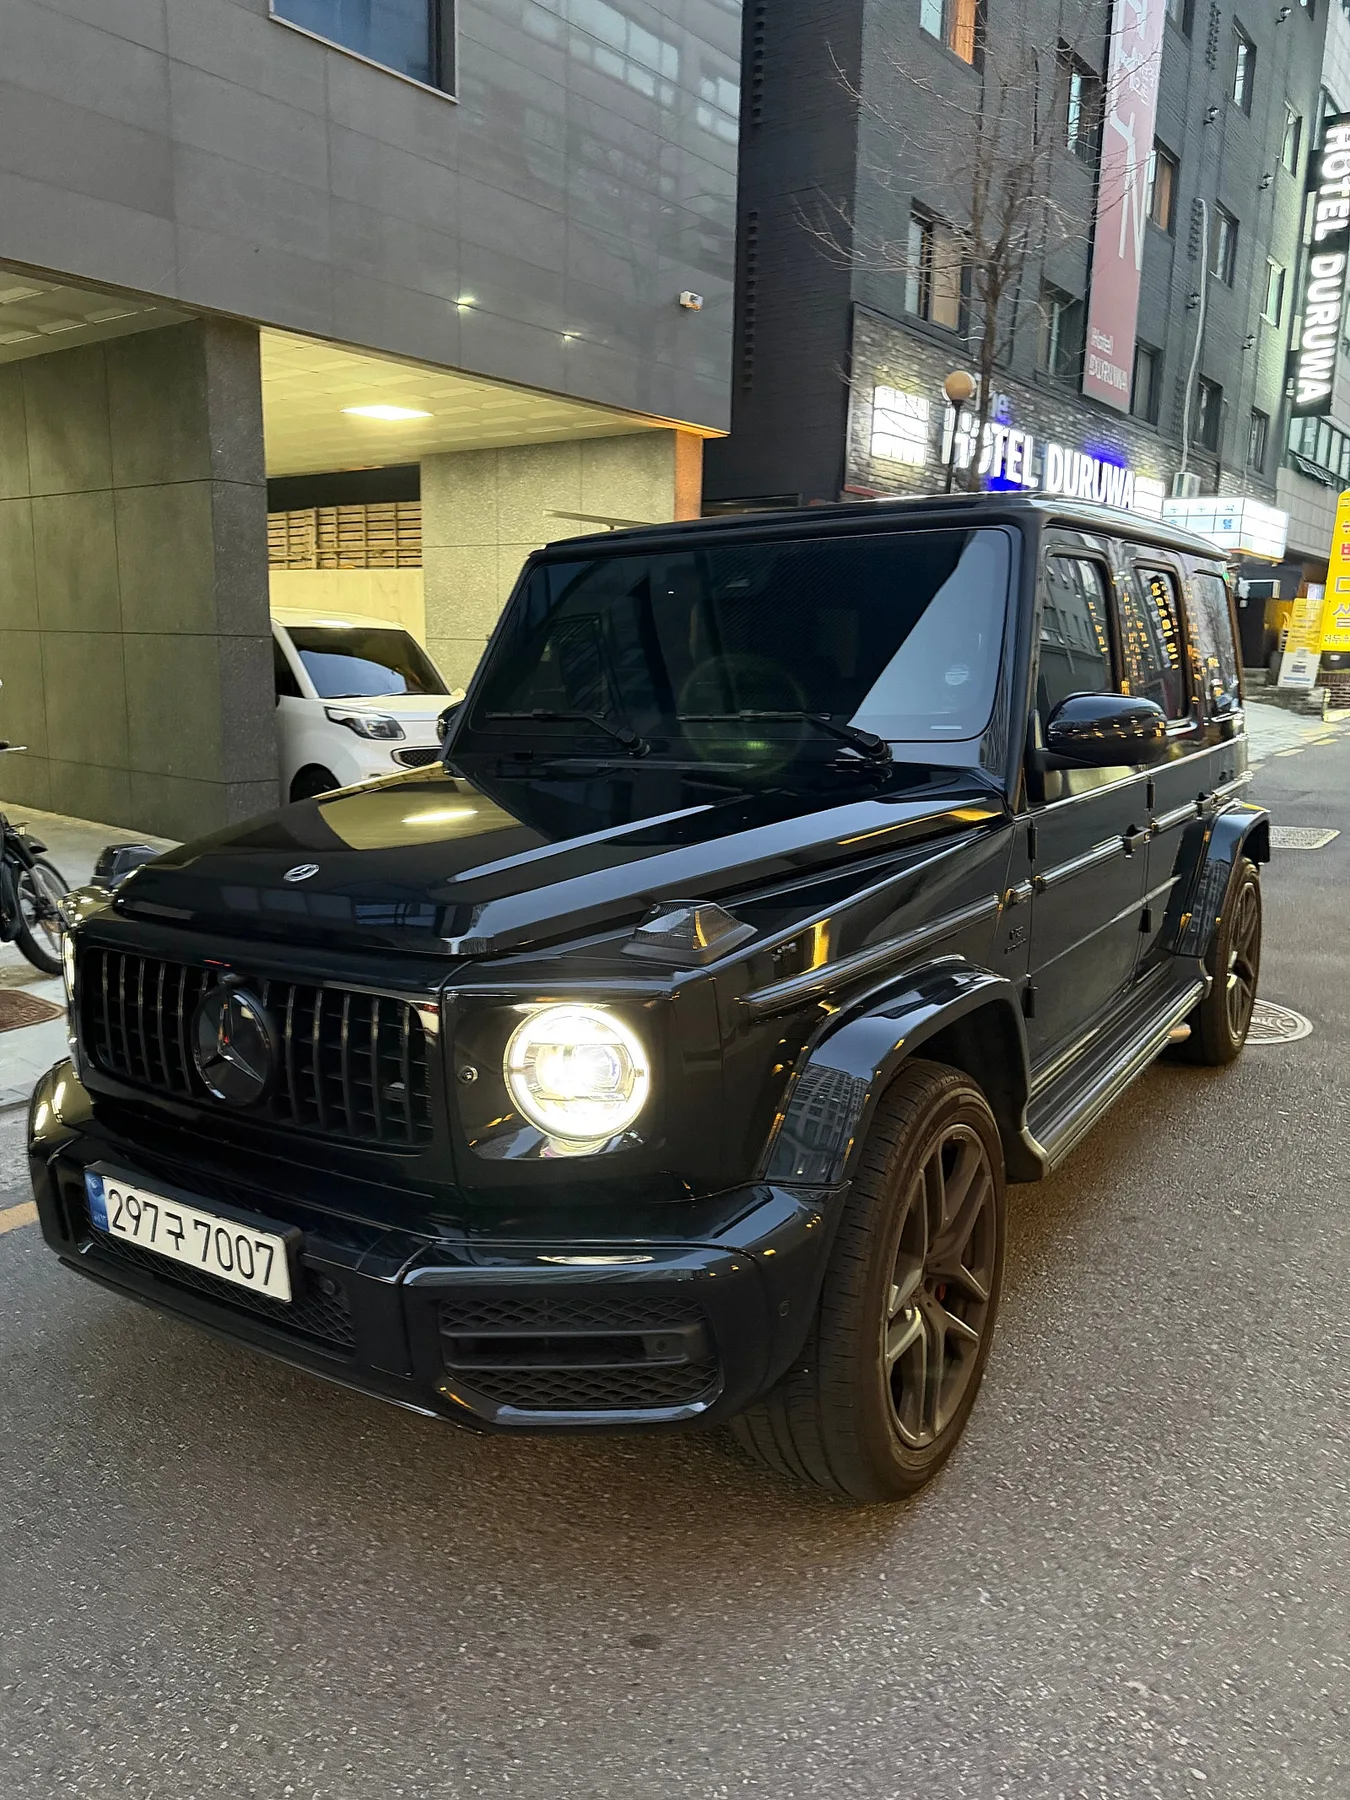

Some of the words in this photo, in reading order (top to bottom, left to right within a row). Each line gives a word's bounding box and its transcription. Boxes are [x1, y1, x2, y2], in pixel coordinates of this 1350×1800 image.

[1314, 125, 1350, 241] HOTEL
[1296, 252, 1347, 404] DURUWA
[941, 405, 1039, 488] HOTEL
[1045, 442, 1135, 508] DURUWA
[107, 1188, 186, 1251] 297구
[193, 1219, 275, 1286] 7007
